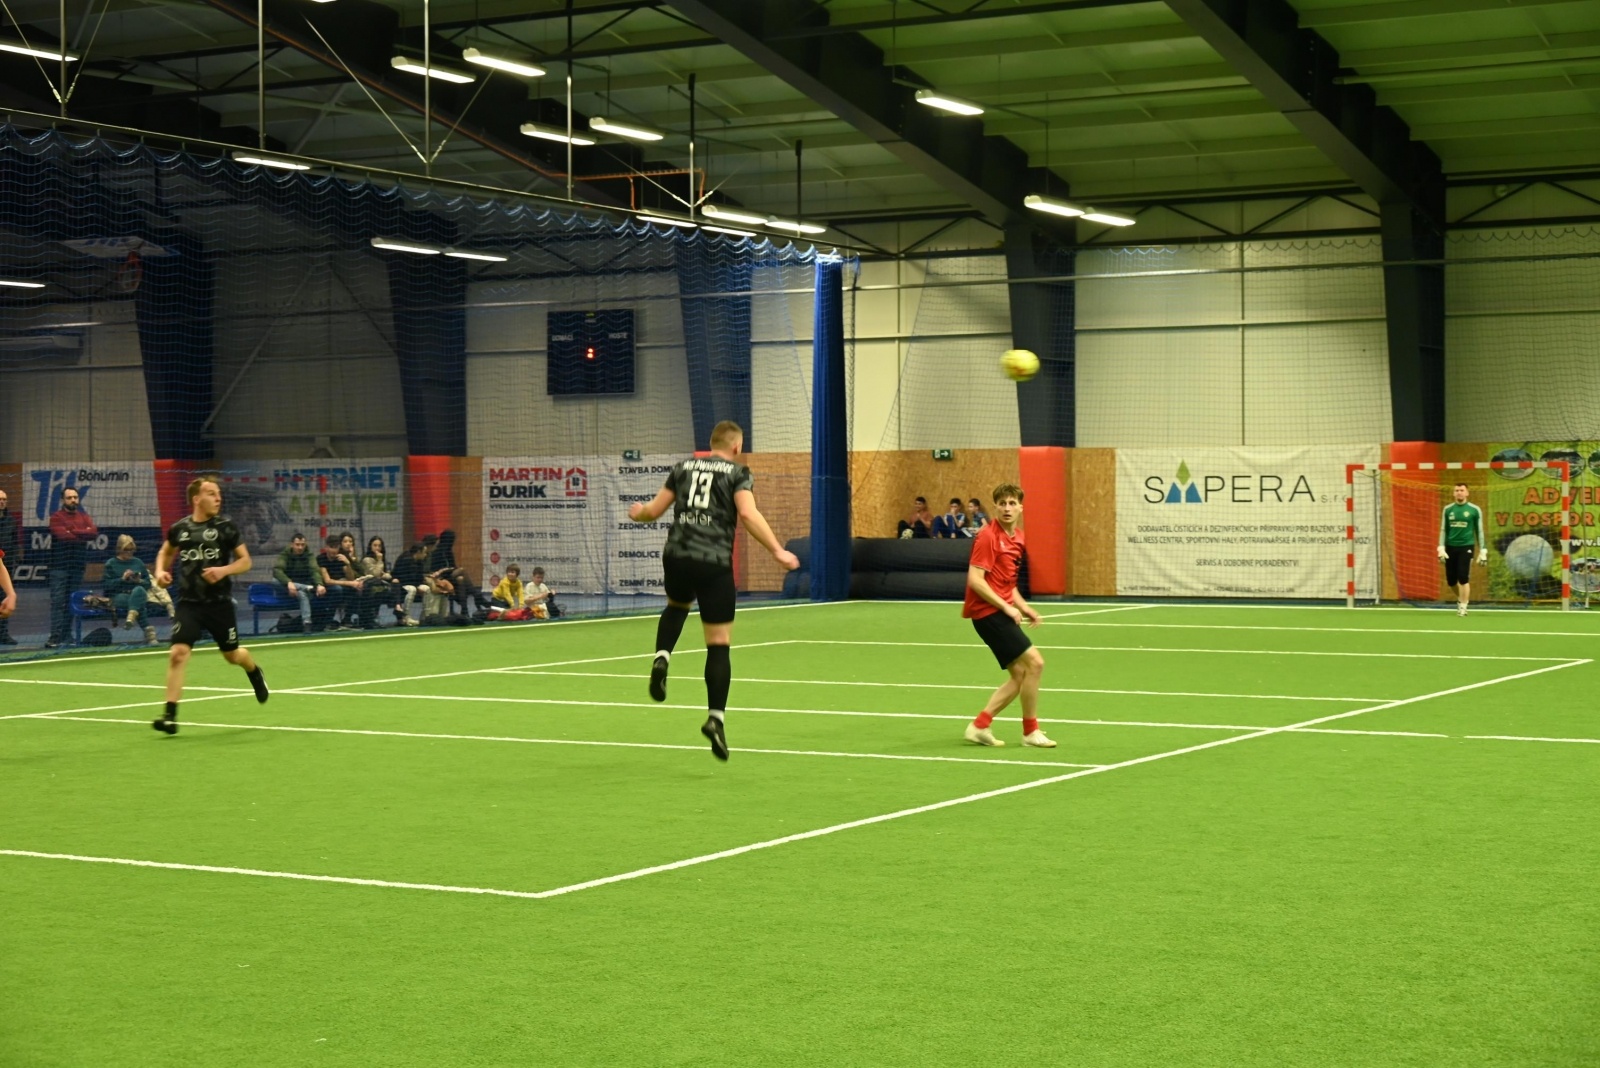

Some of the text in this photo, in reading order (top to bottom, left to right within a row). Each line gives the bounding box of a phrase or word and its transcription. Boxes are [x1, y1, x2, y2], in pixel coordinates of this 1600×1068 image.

[490, 467, 562, 480] MARTIN
[618, 466, 649, 474] STAVBA
[490, 482, 547, 498] ĎURÍK
[687, 471, 713, 509] 13
[289, 495, 302, 512] A
[1494, 512, 1509, 526] V
[1127, 536, 1159, 544] WELLNESS
[180, 543, 220, 561] safer
[1196, 559, 1217, 567] SERVIS
